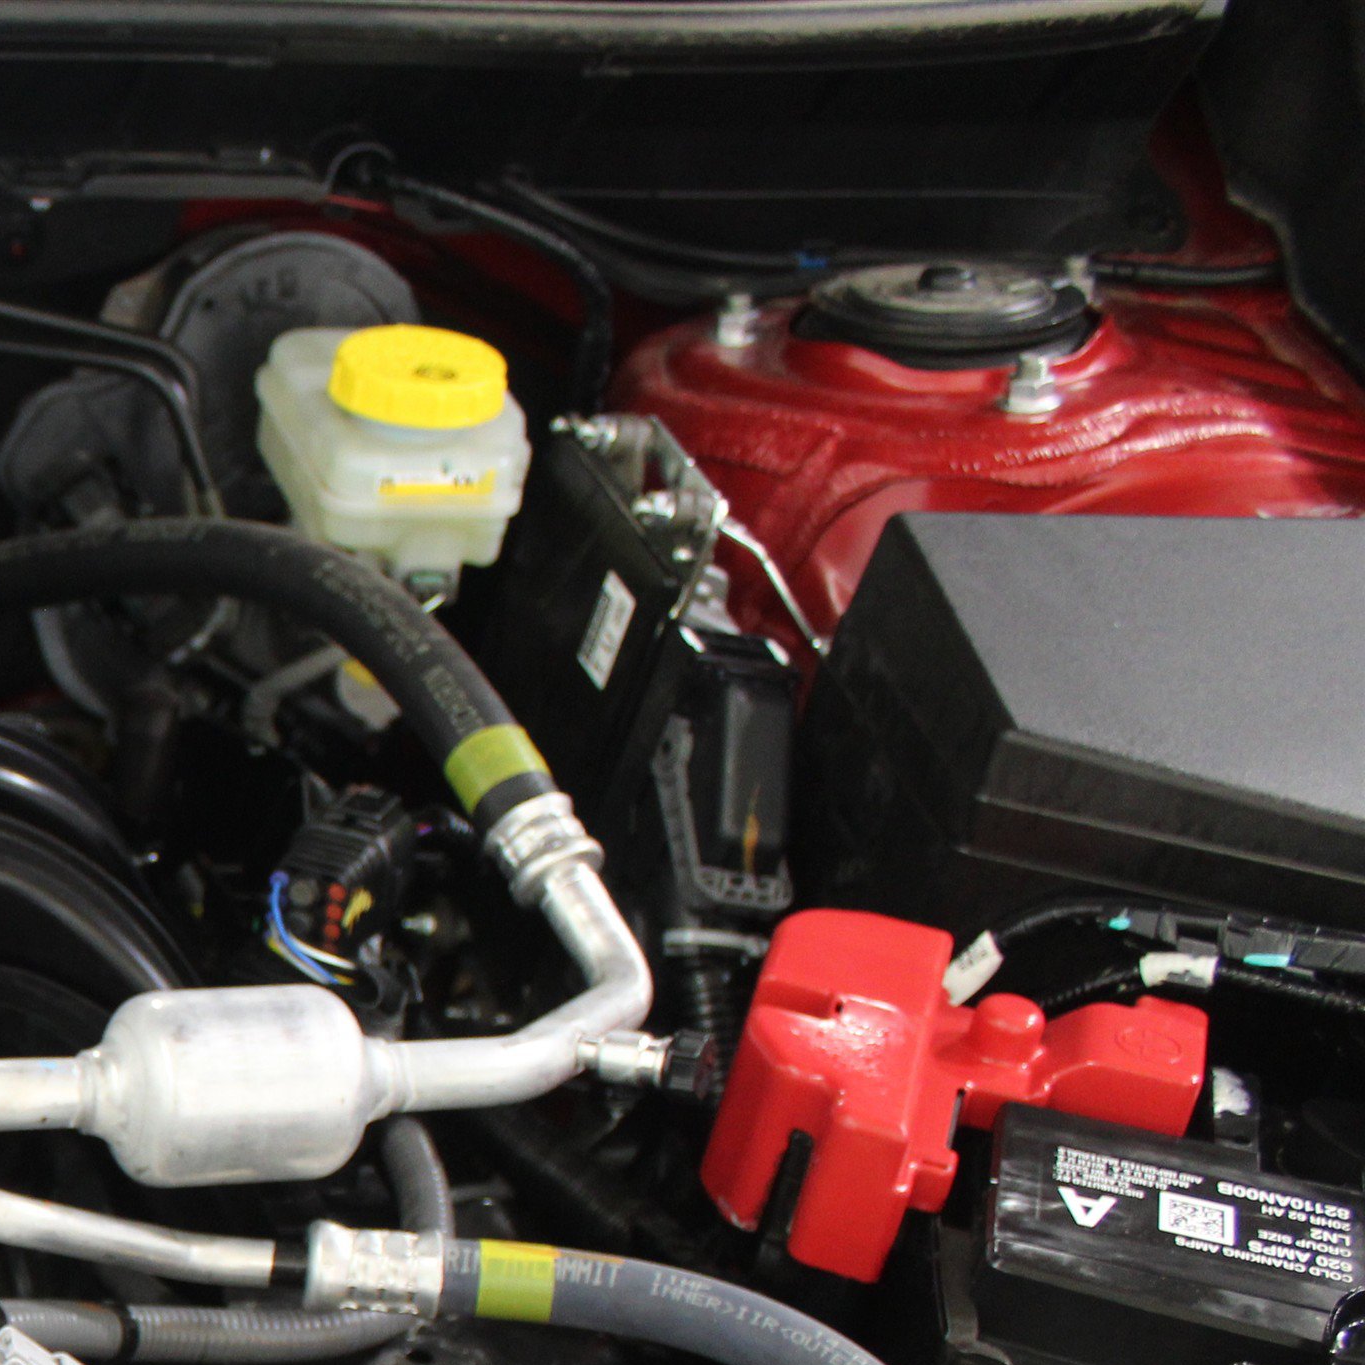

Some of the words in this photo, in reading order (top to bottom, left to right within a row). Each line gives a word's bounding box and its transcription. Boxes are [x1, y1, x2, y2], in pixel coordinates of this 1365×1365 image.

[1217, 1181, 1350, 1220] 82110AN00B
[1261, 1204, 1282, 1217] AH
[1288, 1209, 1306, 1222] 62
[1310, 1214, 1350, 1231] 20HR
[1175, 1234, 1219, 1253] AMPS
[1258, 1228, 1291, 1245] SIZE
[1309, 1227, 1350, 1246] LN2
[1247, 1239, 1311, 1263] AMPS
[1295, 1236, 1351, 1258] GROUP
[1222, 1245, 1305, 1273] CRANKING
[1316, 1253, 1353, 1272] 620
[1309, 1265, 1352, 1284] COLD
